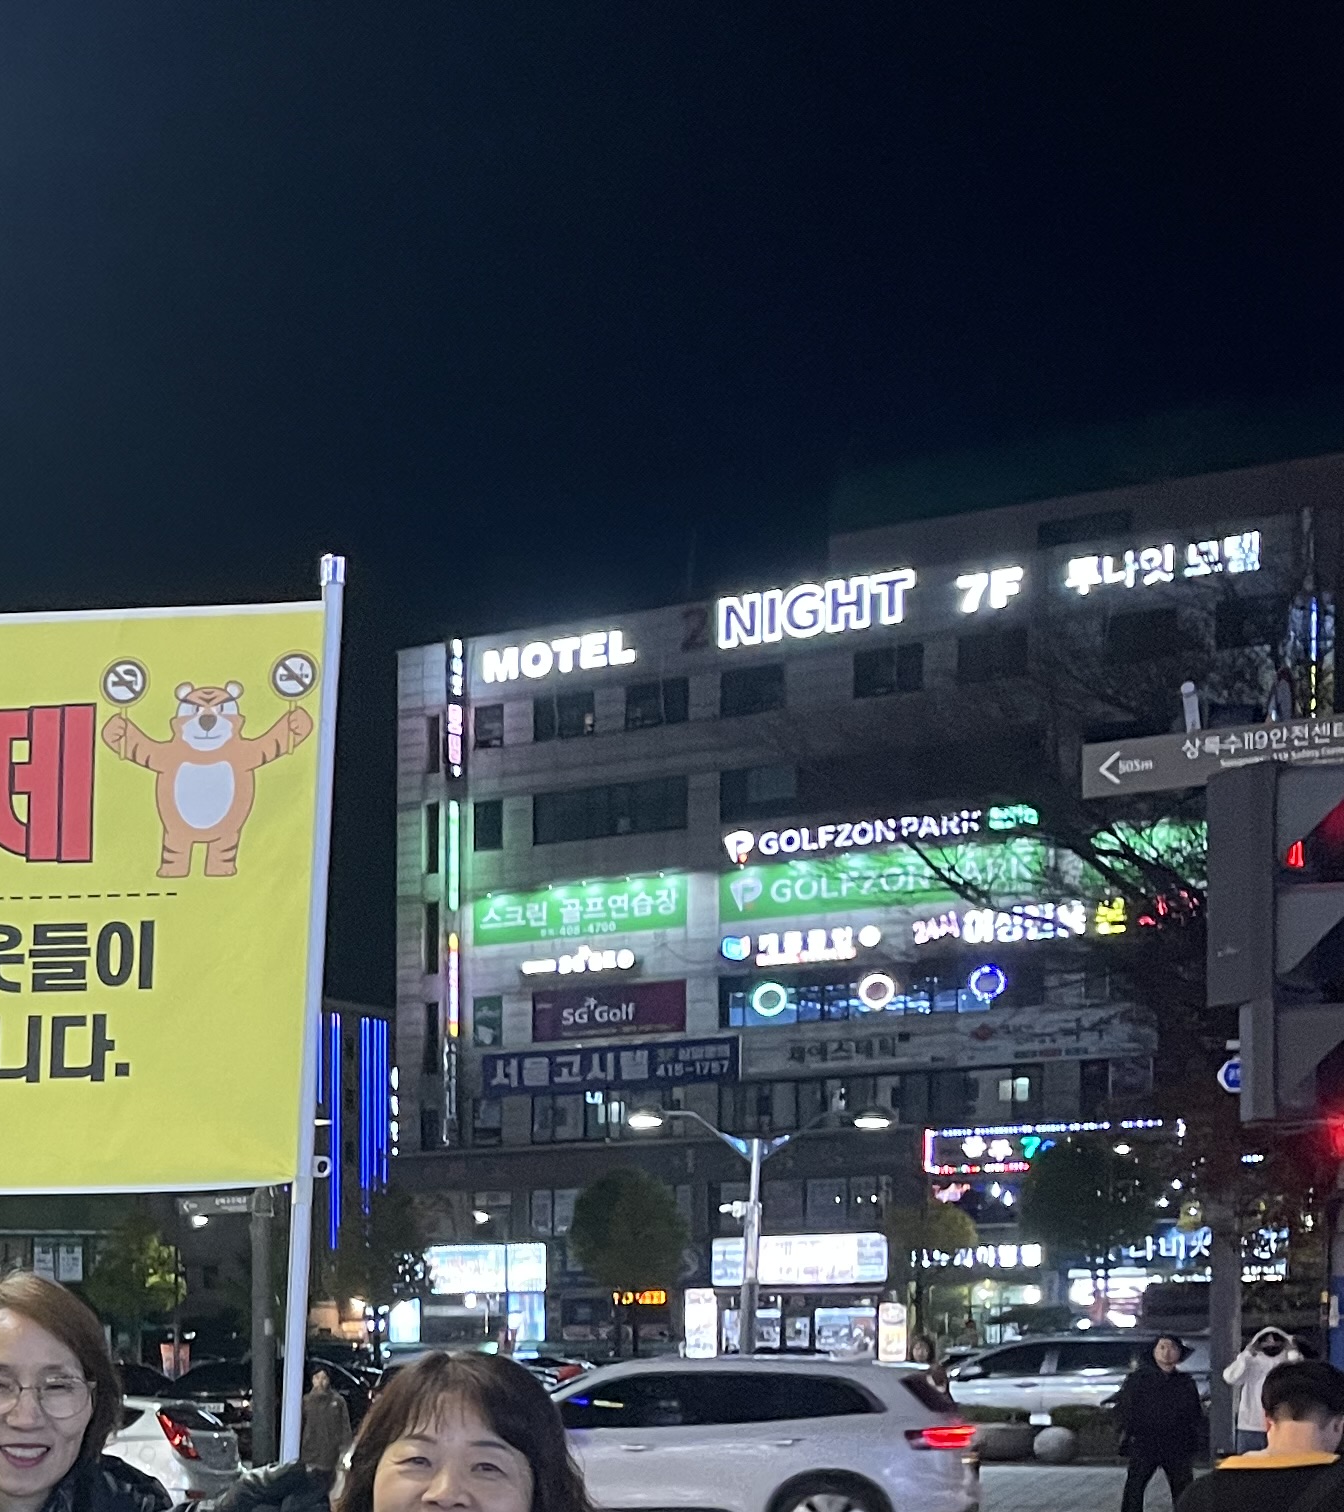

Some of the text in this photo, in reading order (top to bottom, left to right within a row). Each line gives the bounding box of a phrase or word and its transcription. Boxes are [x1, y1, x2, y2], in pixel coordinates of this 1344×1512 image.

[482, 630, 637, 684] MOTEL
[717, 568, 917, 650] NIGHT
[955, 566, 1024, 614] 7F
[758, 819, 897, 856] GOLFZON
[900, 808, 982, 839] PARK
[770, 866, 932, 903] GOLFZON
[480, 887, 679, 929] 스크린 골프연습장
[561, 1002, 635, 1026] SG Golf
